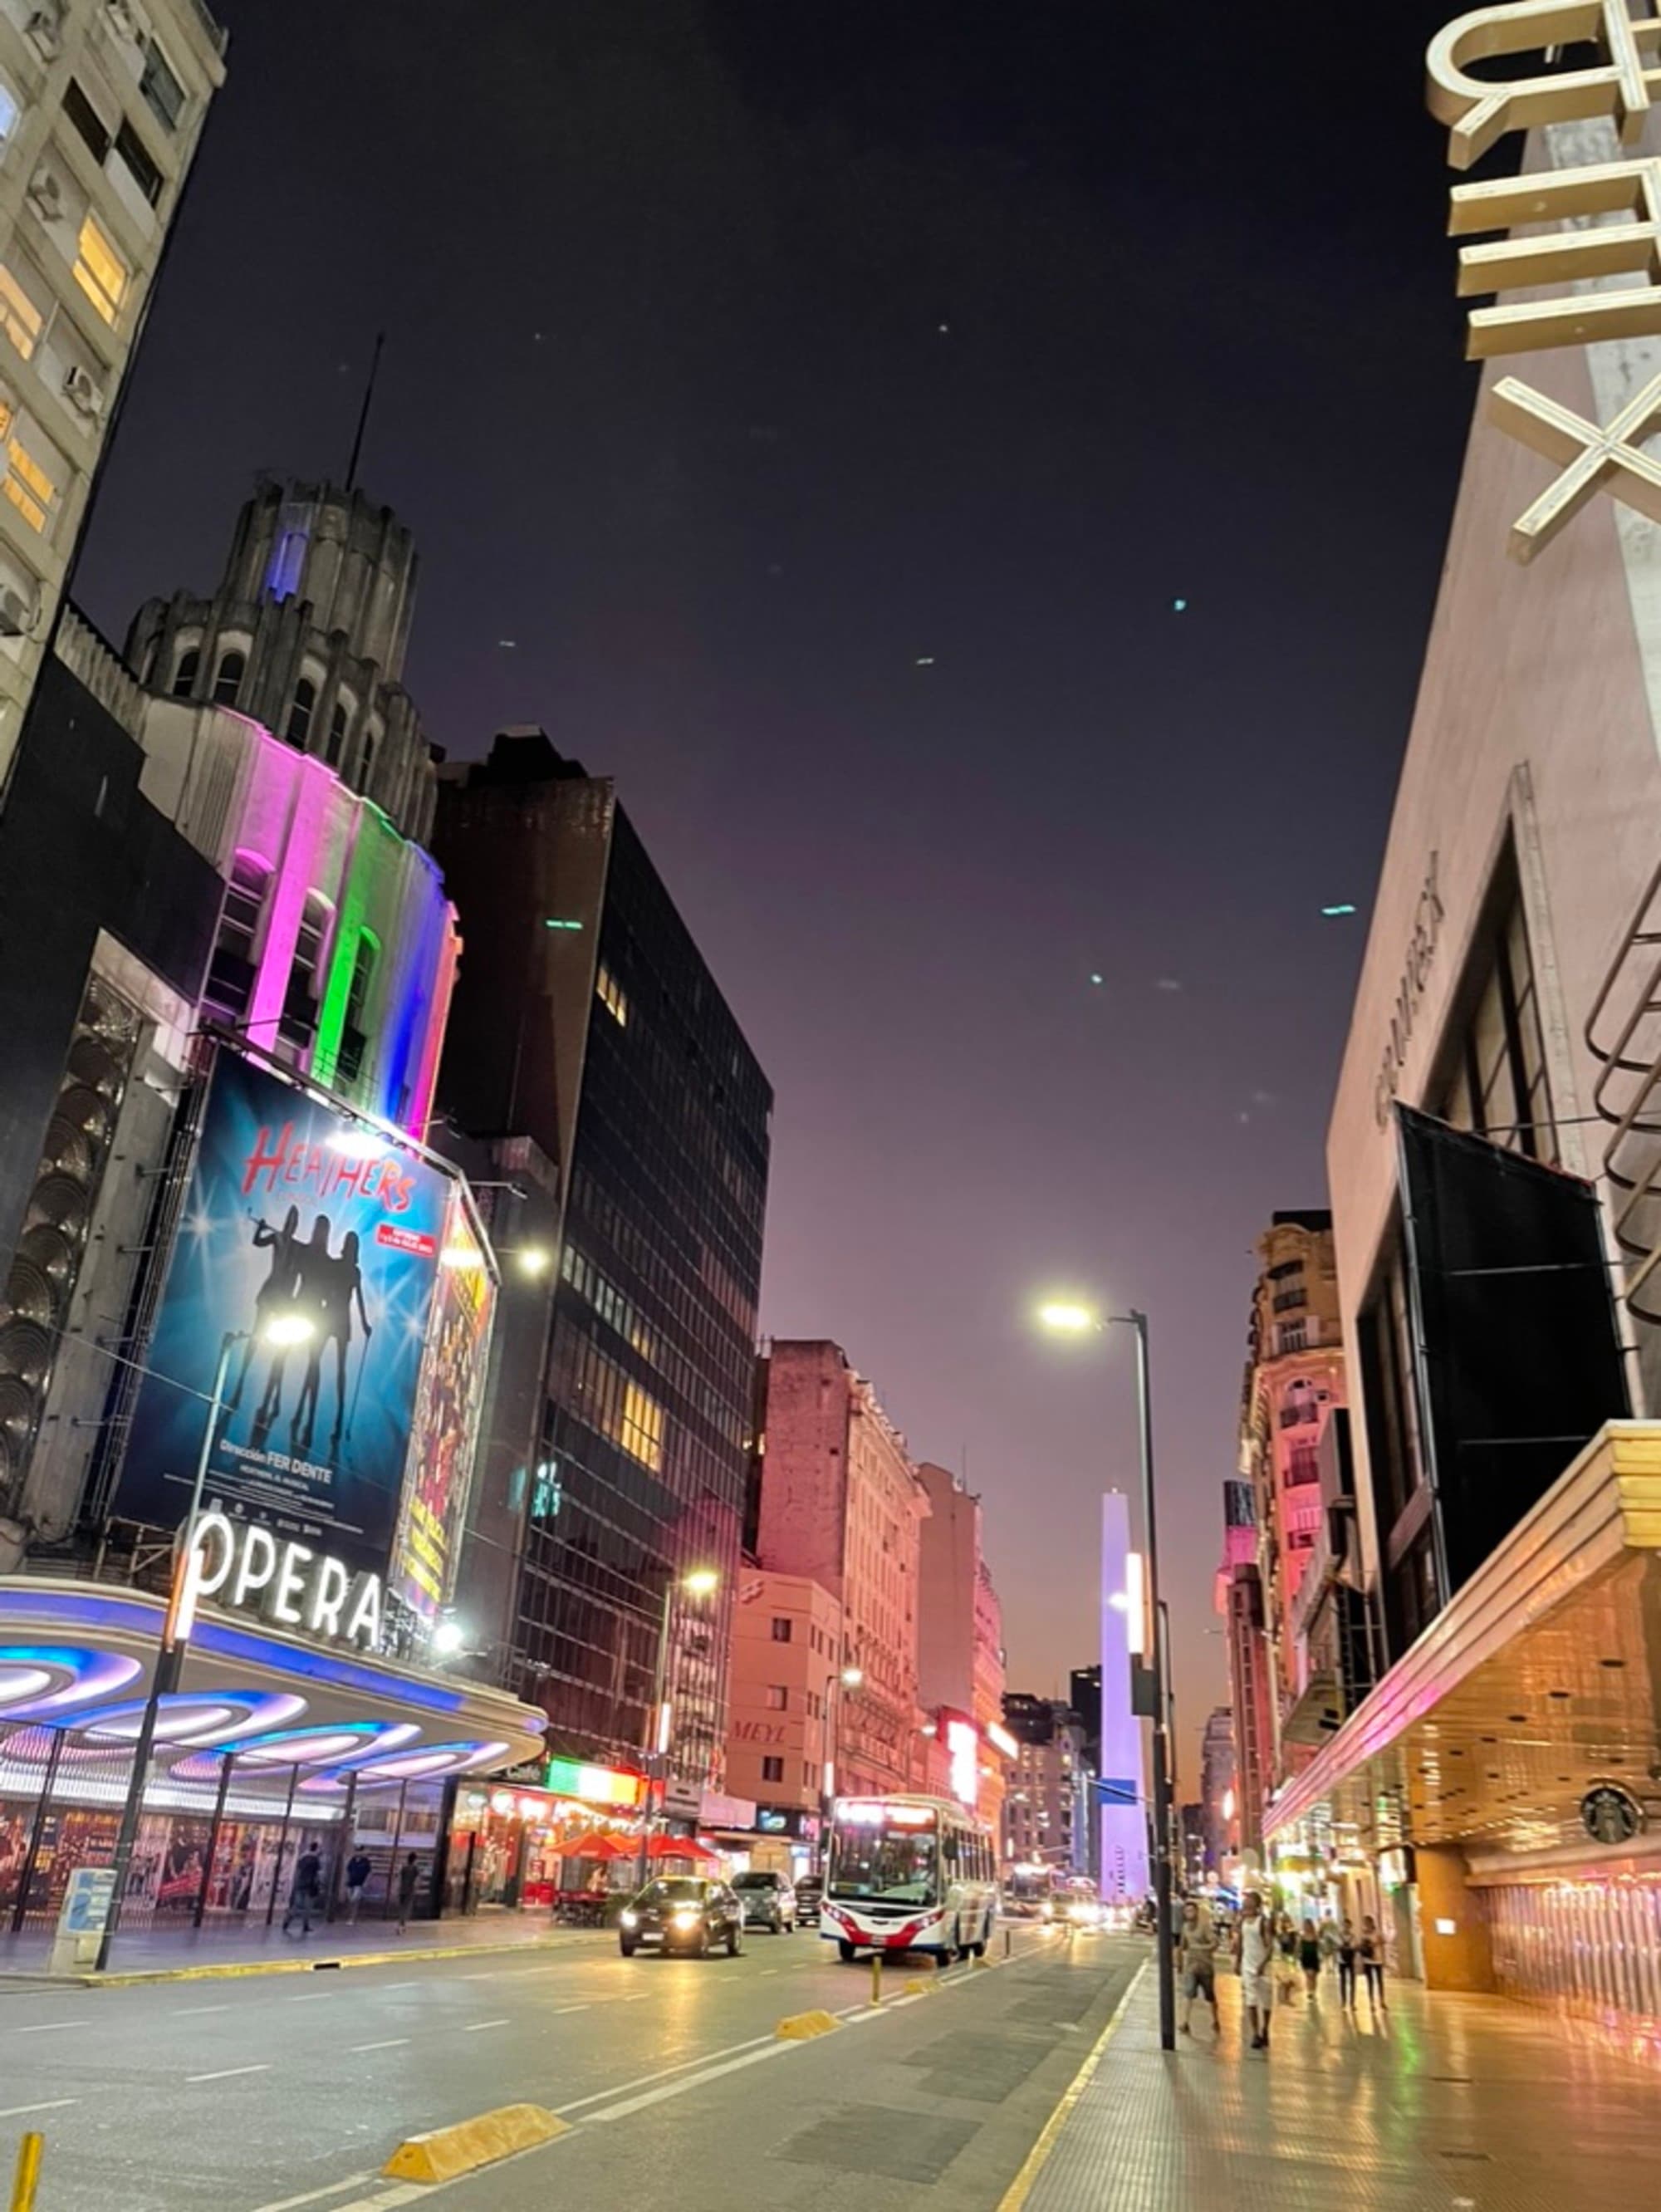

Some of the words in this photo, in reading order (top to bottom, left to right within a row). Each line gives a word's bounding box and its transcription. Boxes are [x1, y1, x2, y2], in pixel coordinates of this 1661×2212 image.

[267, 1451, 291, 1471] FER
[292, 1458, 332, 1484] DENTE
[189, 1513, 381, 1650] OPERA
